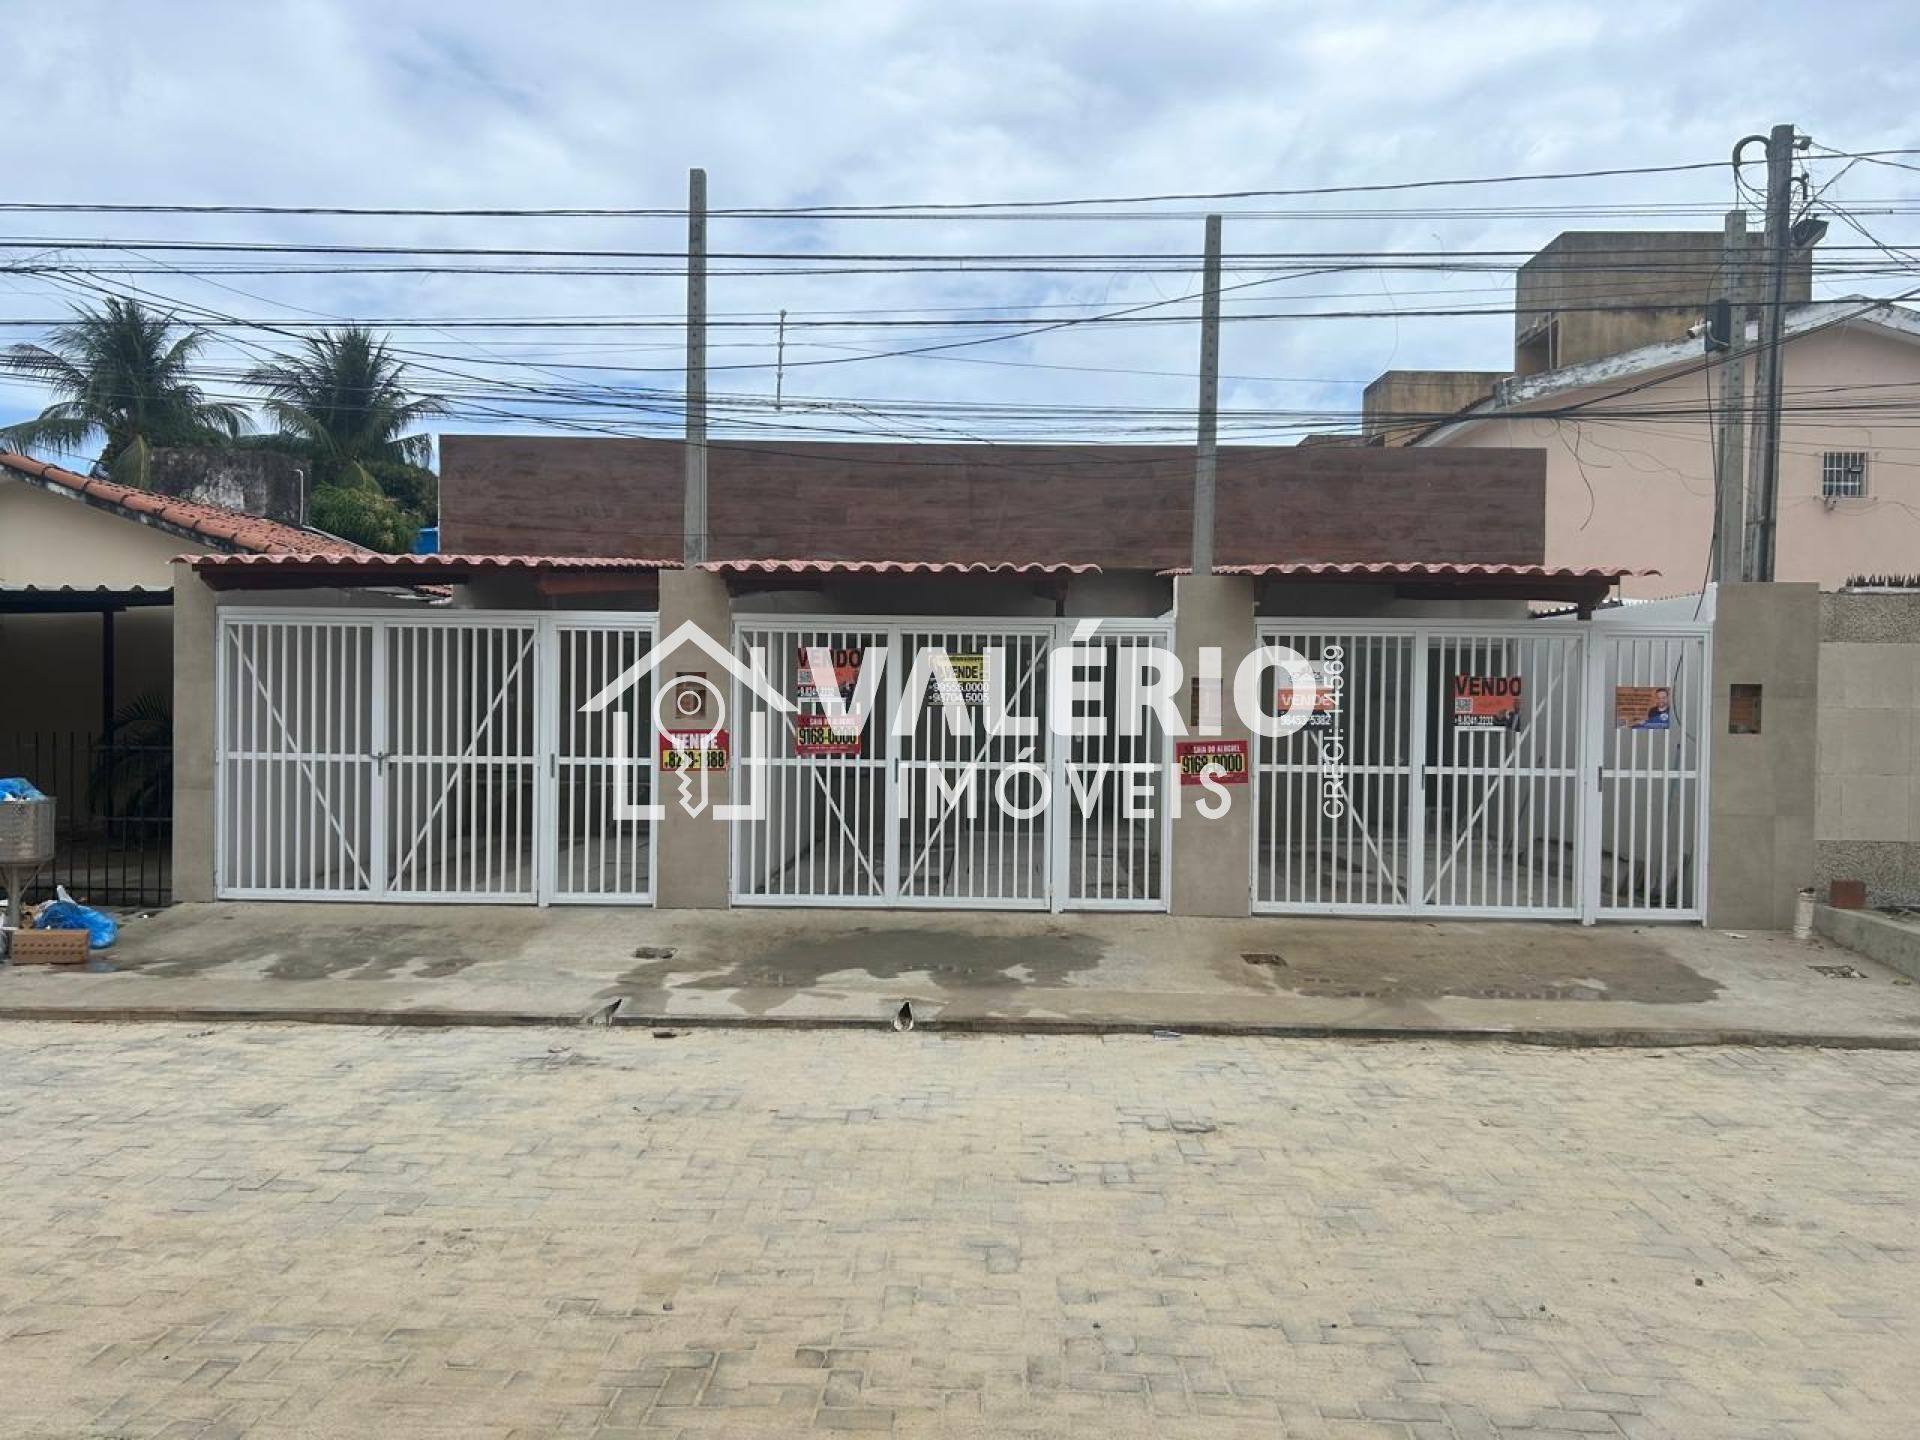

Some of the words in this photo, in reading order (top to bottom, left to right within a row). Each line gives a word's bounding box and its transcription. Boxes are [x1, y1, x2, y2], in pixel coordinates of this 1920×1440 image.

[797, 647, 861, 667] VENDO
[1456, 676, 1521, 696] VENDO
[799, 728, 856, 744] 9168-0000
